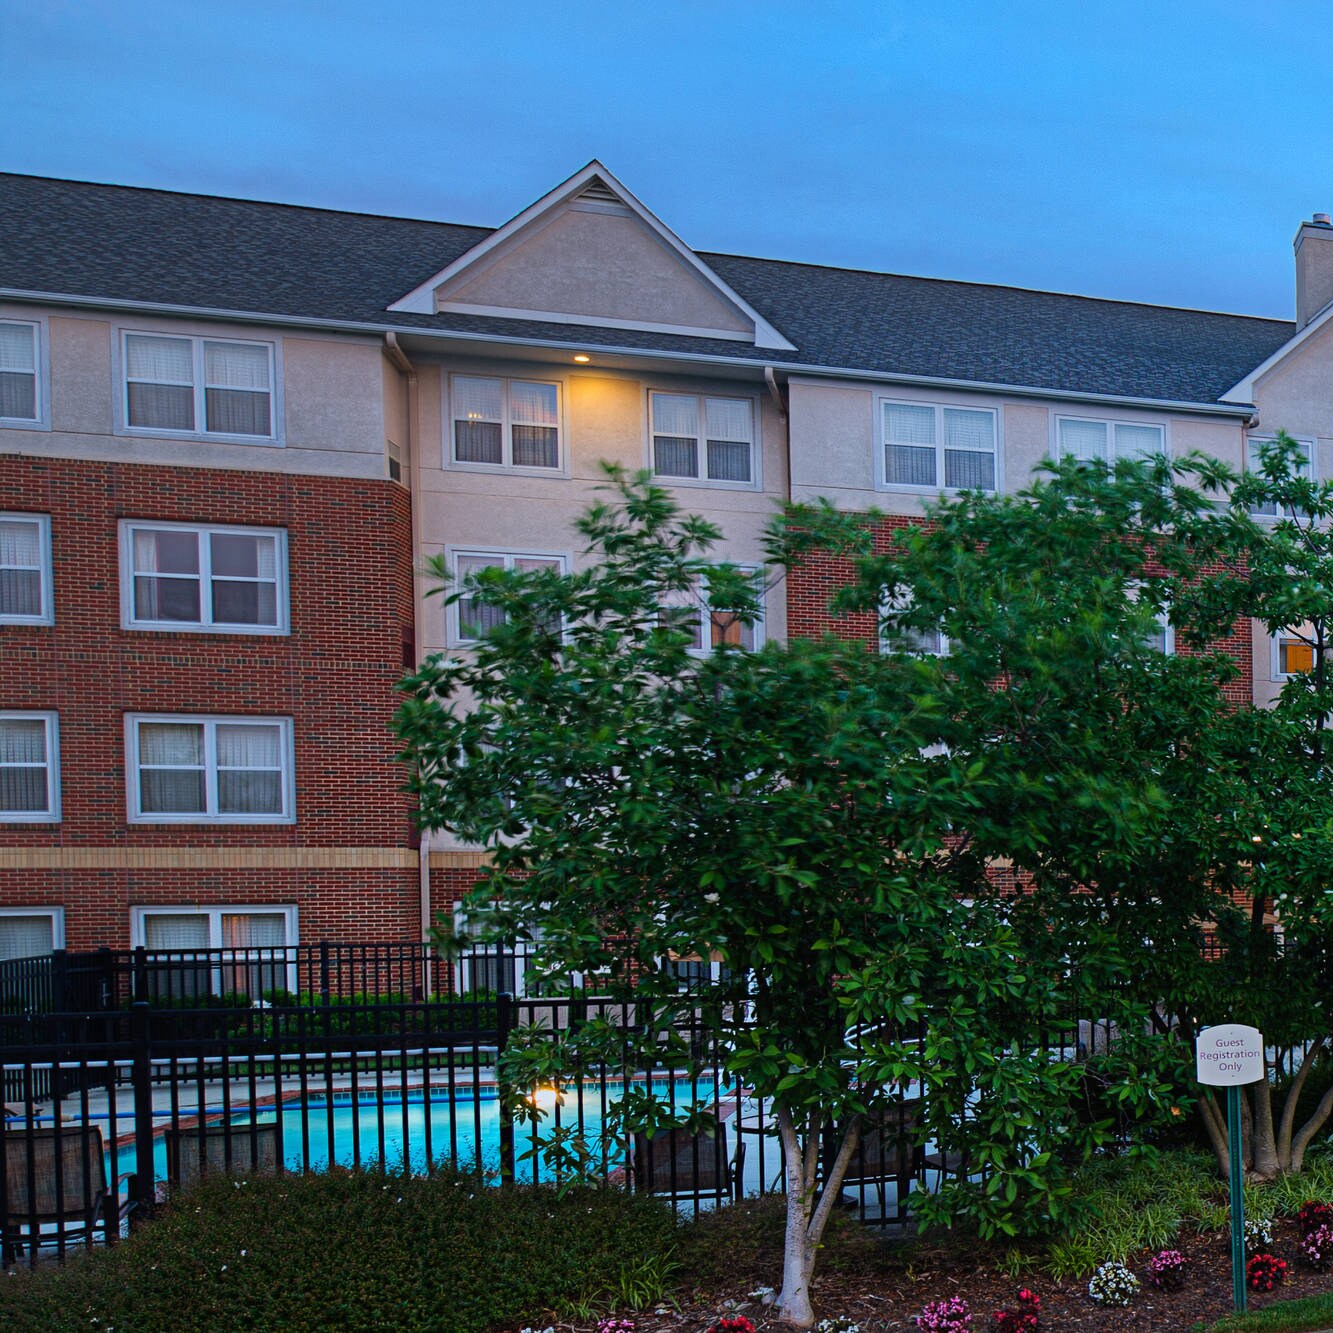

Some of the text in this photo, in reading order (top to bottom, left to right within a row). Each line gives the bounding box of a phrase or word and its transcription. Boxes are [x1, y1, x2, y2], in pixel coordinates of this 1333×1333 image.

[1216, 1039, 1244, 1048] Guest
[1200, 1050, 1260, 1061] Registration
[1219, 1062, 1242, 1072] Only
